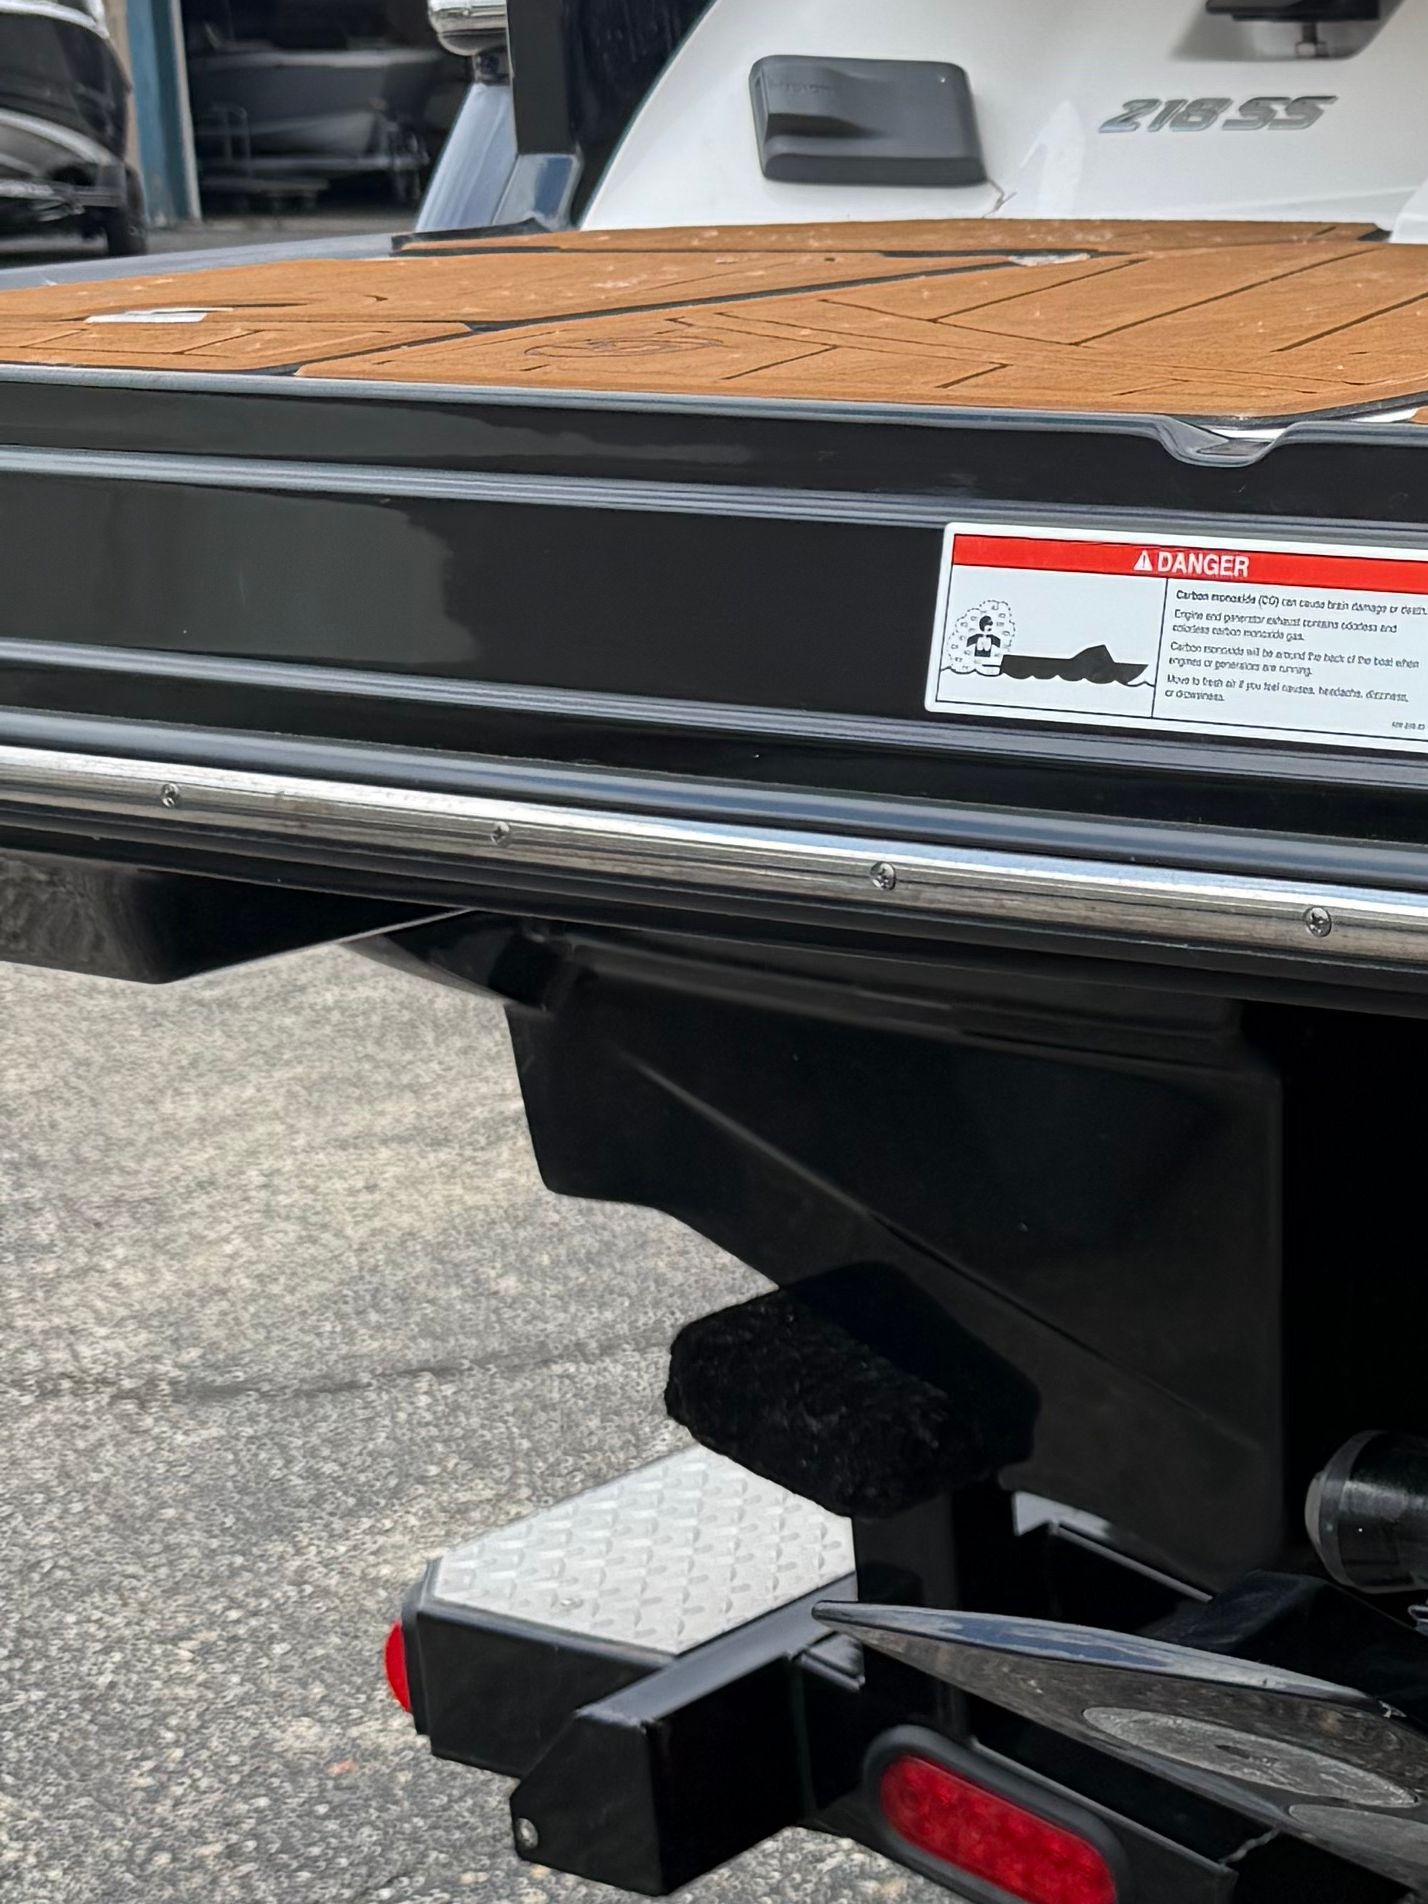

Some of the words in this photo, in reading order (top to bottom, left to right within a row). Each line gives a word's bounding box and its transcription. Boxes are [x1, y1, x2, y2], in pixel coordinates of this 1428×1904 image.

[1100, 97, 1231, 133] 218
[1222, 96, 1338, 130] SS
[1158, 551, 1250, 577] DANGER
[1176, 590, 1209, 601] Carbon
[1258, 595, 1280, 608] (CO)
[1281, 598, 1297, 607] can
[1299, 599, 1325, 609] cause
[1327, 600, 1349, 610] brain
[1351, 602, 1387, 615] damage
[1174, 609, 1203, 621] Engine
[1206, 612, 1222, 622] and
[1380, 624, 1398, 633] and
[1212, 626, 1242, 637] carbon
[1170, 641, 1202, 653] Carbon
[1323, 653, 1345, 664] back
